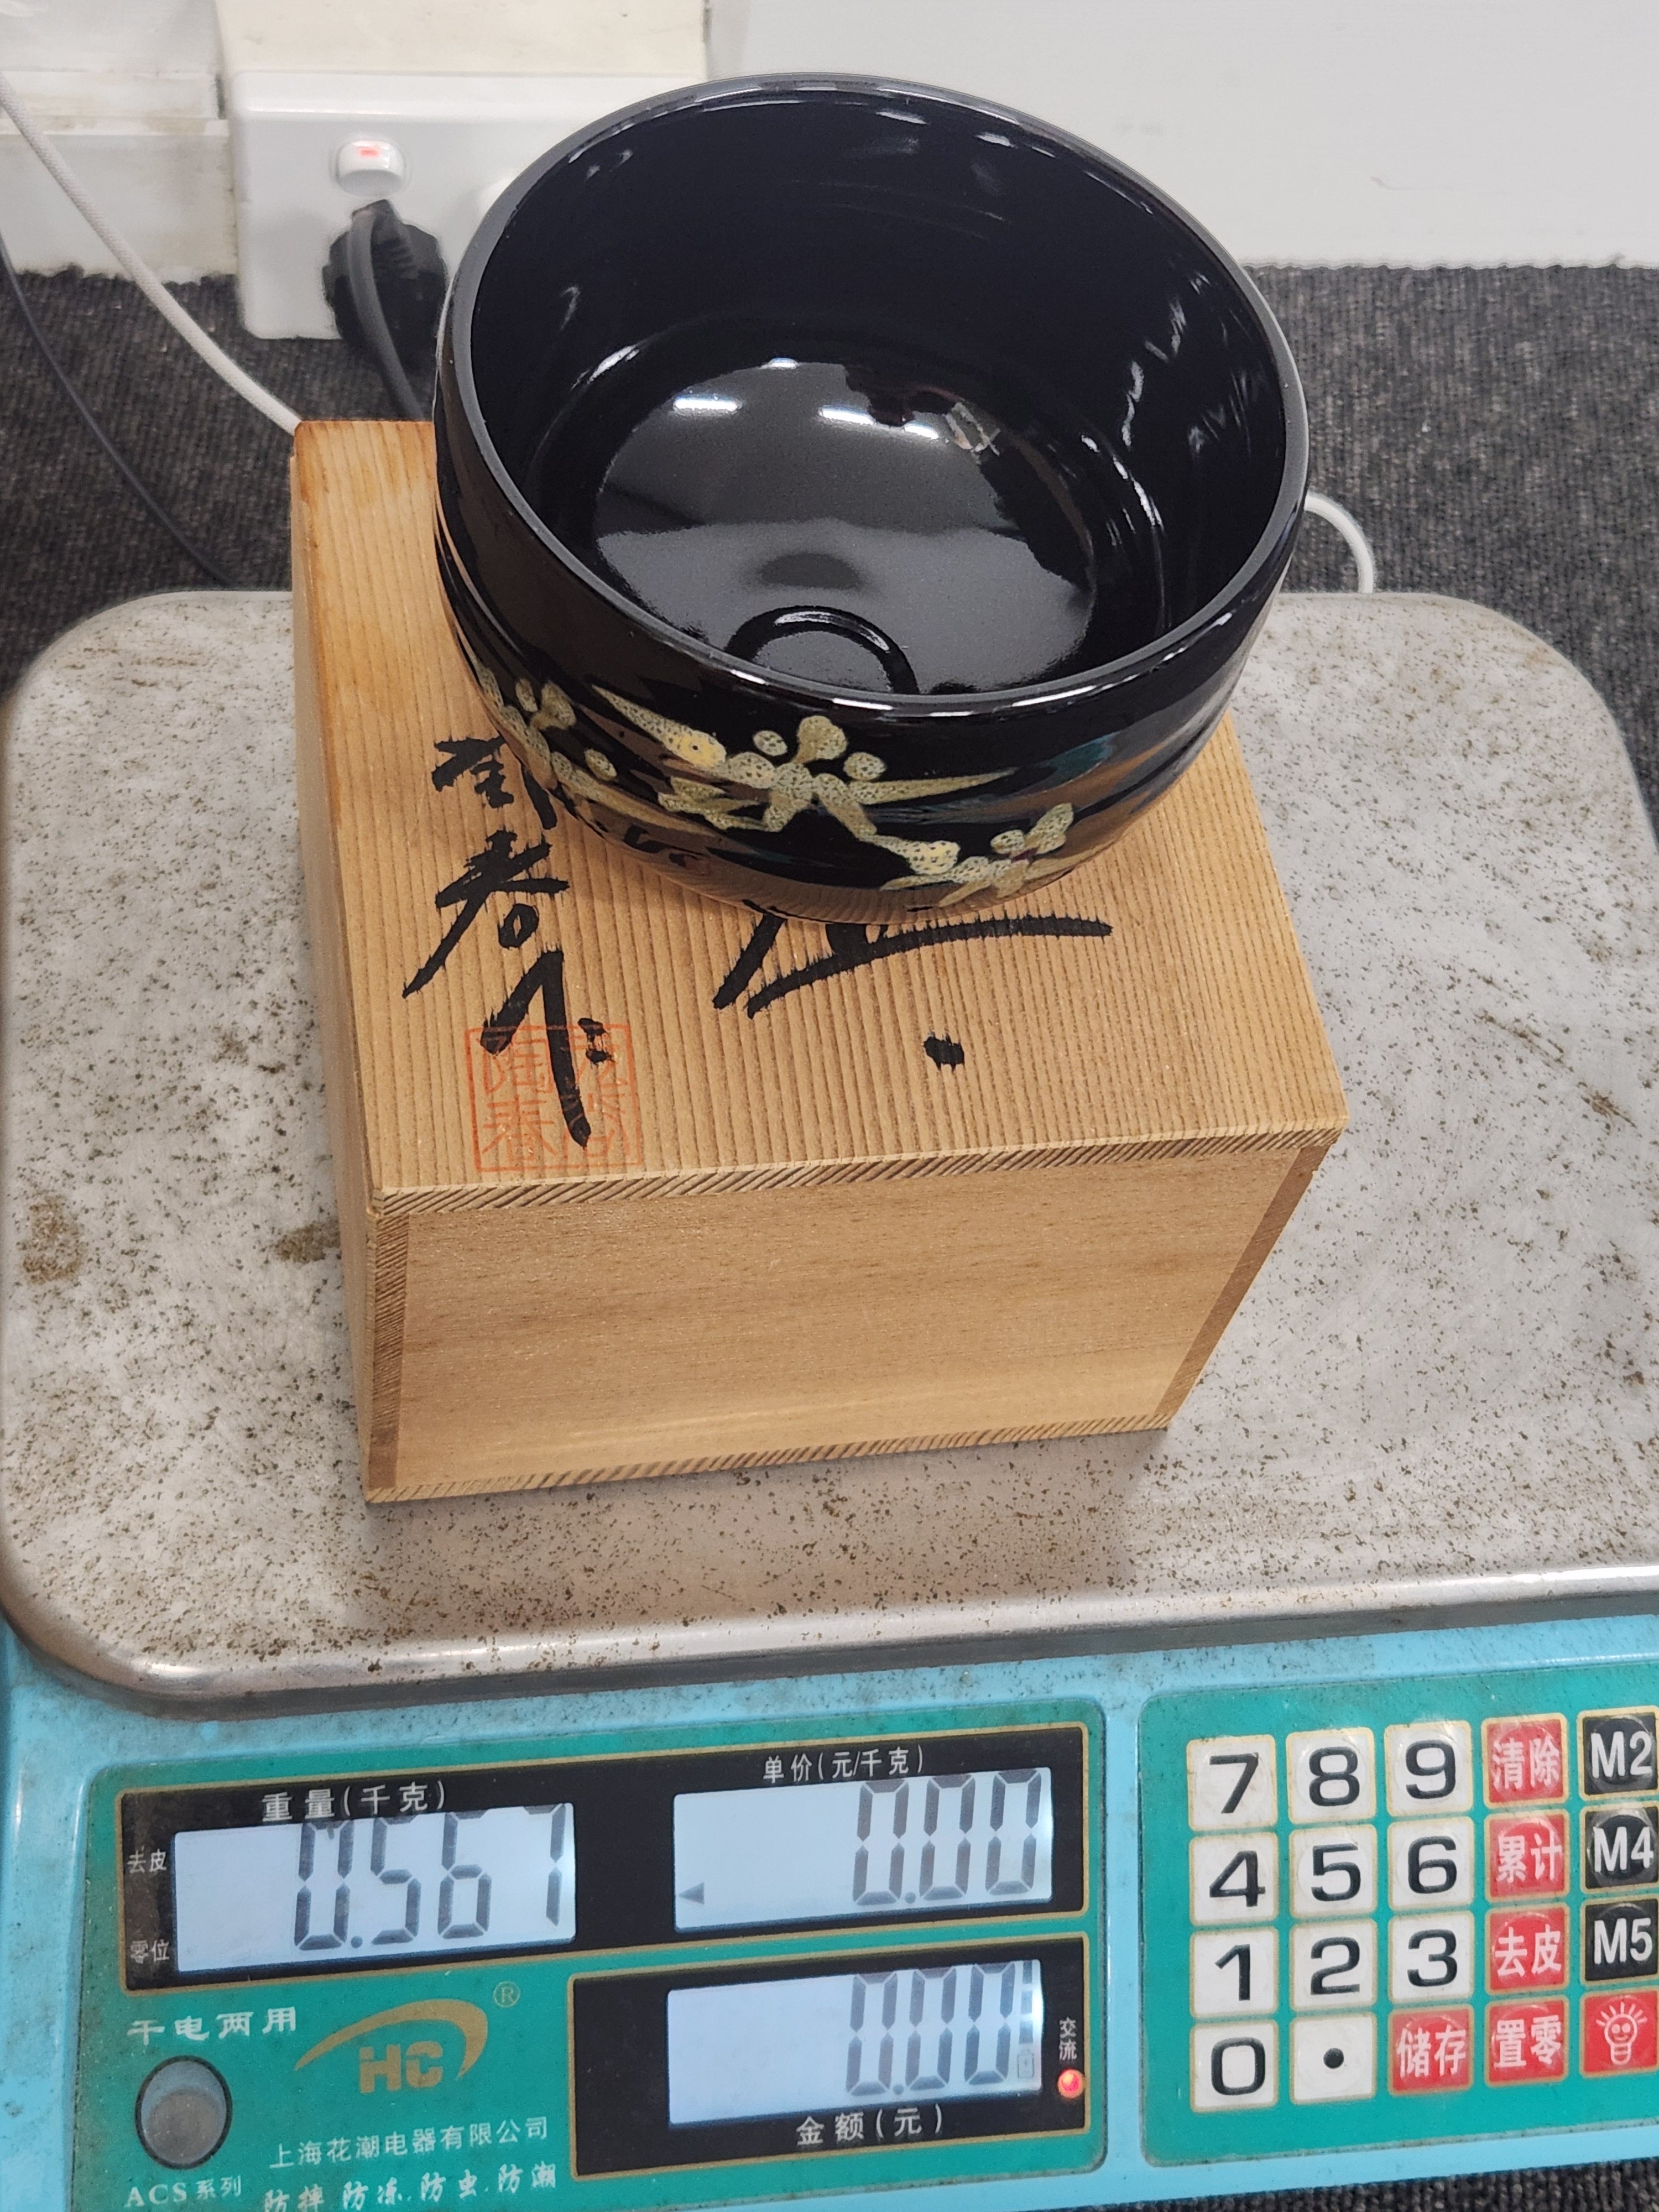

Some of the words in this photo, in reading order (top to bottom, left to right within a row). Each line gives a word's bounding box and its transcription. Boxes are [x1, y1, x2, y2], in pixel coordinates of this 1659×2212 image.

[1308, 1746, 1360, 1808] 8
[1405, 1740, 1457, 1800] 9
[1492, 1738, 1560, 1791] 清除
[1590, 1730, 1652, 1778] M2
[1209, 1752, 1260, 1814] 7
[126, 1846, 168, 1875] 去皮
[852, 1770, 1042, 1906] 0.00
[1496, 1832, 1562, 1882] 累计
[1593, 1826, 1653, 1872] M4
[1209, 1850, 1266, 1908] 4
[1311, 1844, 1362, 1902] 5
[1407, 1835, 1458, 1895] 6
[129, 1939, 170, 1965] 零位
[1310, 1936, 1361, 1996] 2
[1407, 1929, 1458, 1988] 3
[1495, 1924, 1562, 1977] 去皮
[1594, 1917, 1653, 1964] M5
[1214, 1943, 1251, 2002] 1
[127, 2006, 297, 2046] 干电两用
[846, 1962, 1016, 2097] 0.00
[1058, 2016, 1078, 2061] 交流
[1397, 2026, 1467, 2078] 储存
[1494, 2015, 1562, 2068] 置零
[359, 2040, 444, 2094] HC
[1211, 2037, 1266, 2096] 0
[269, 2116, 549, 2169] 上海花潮电器有限公司
